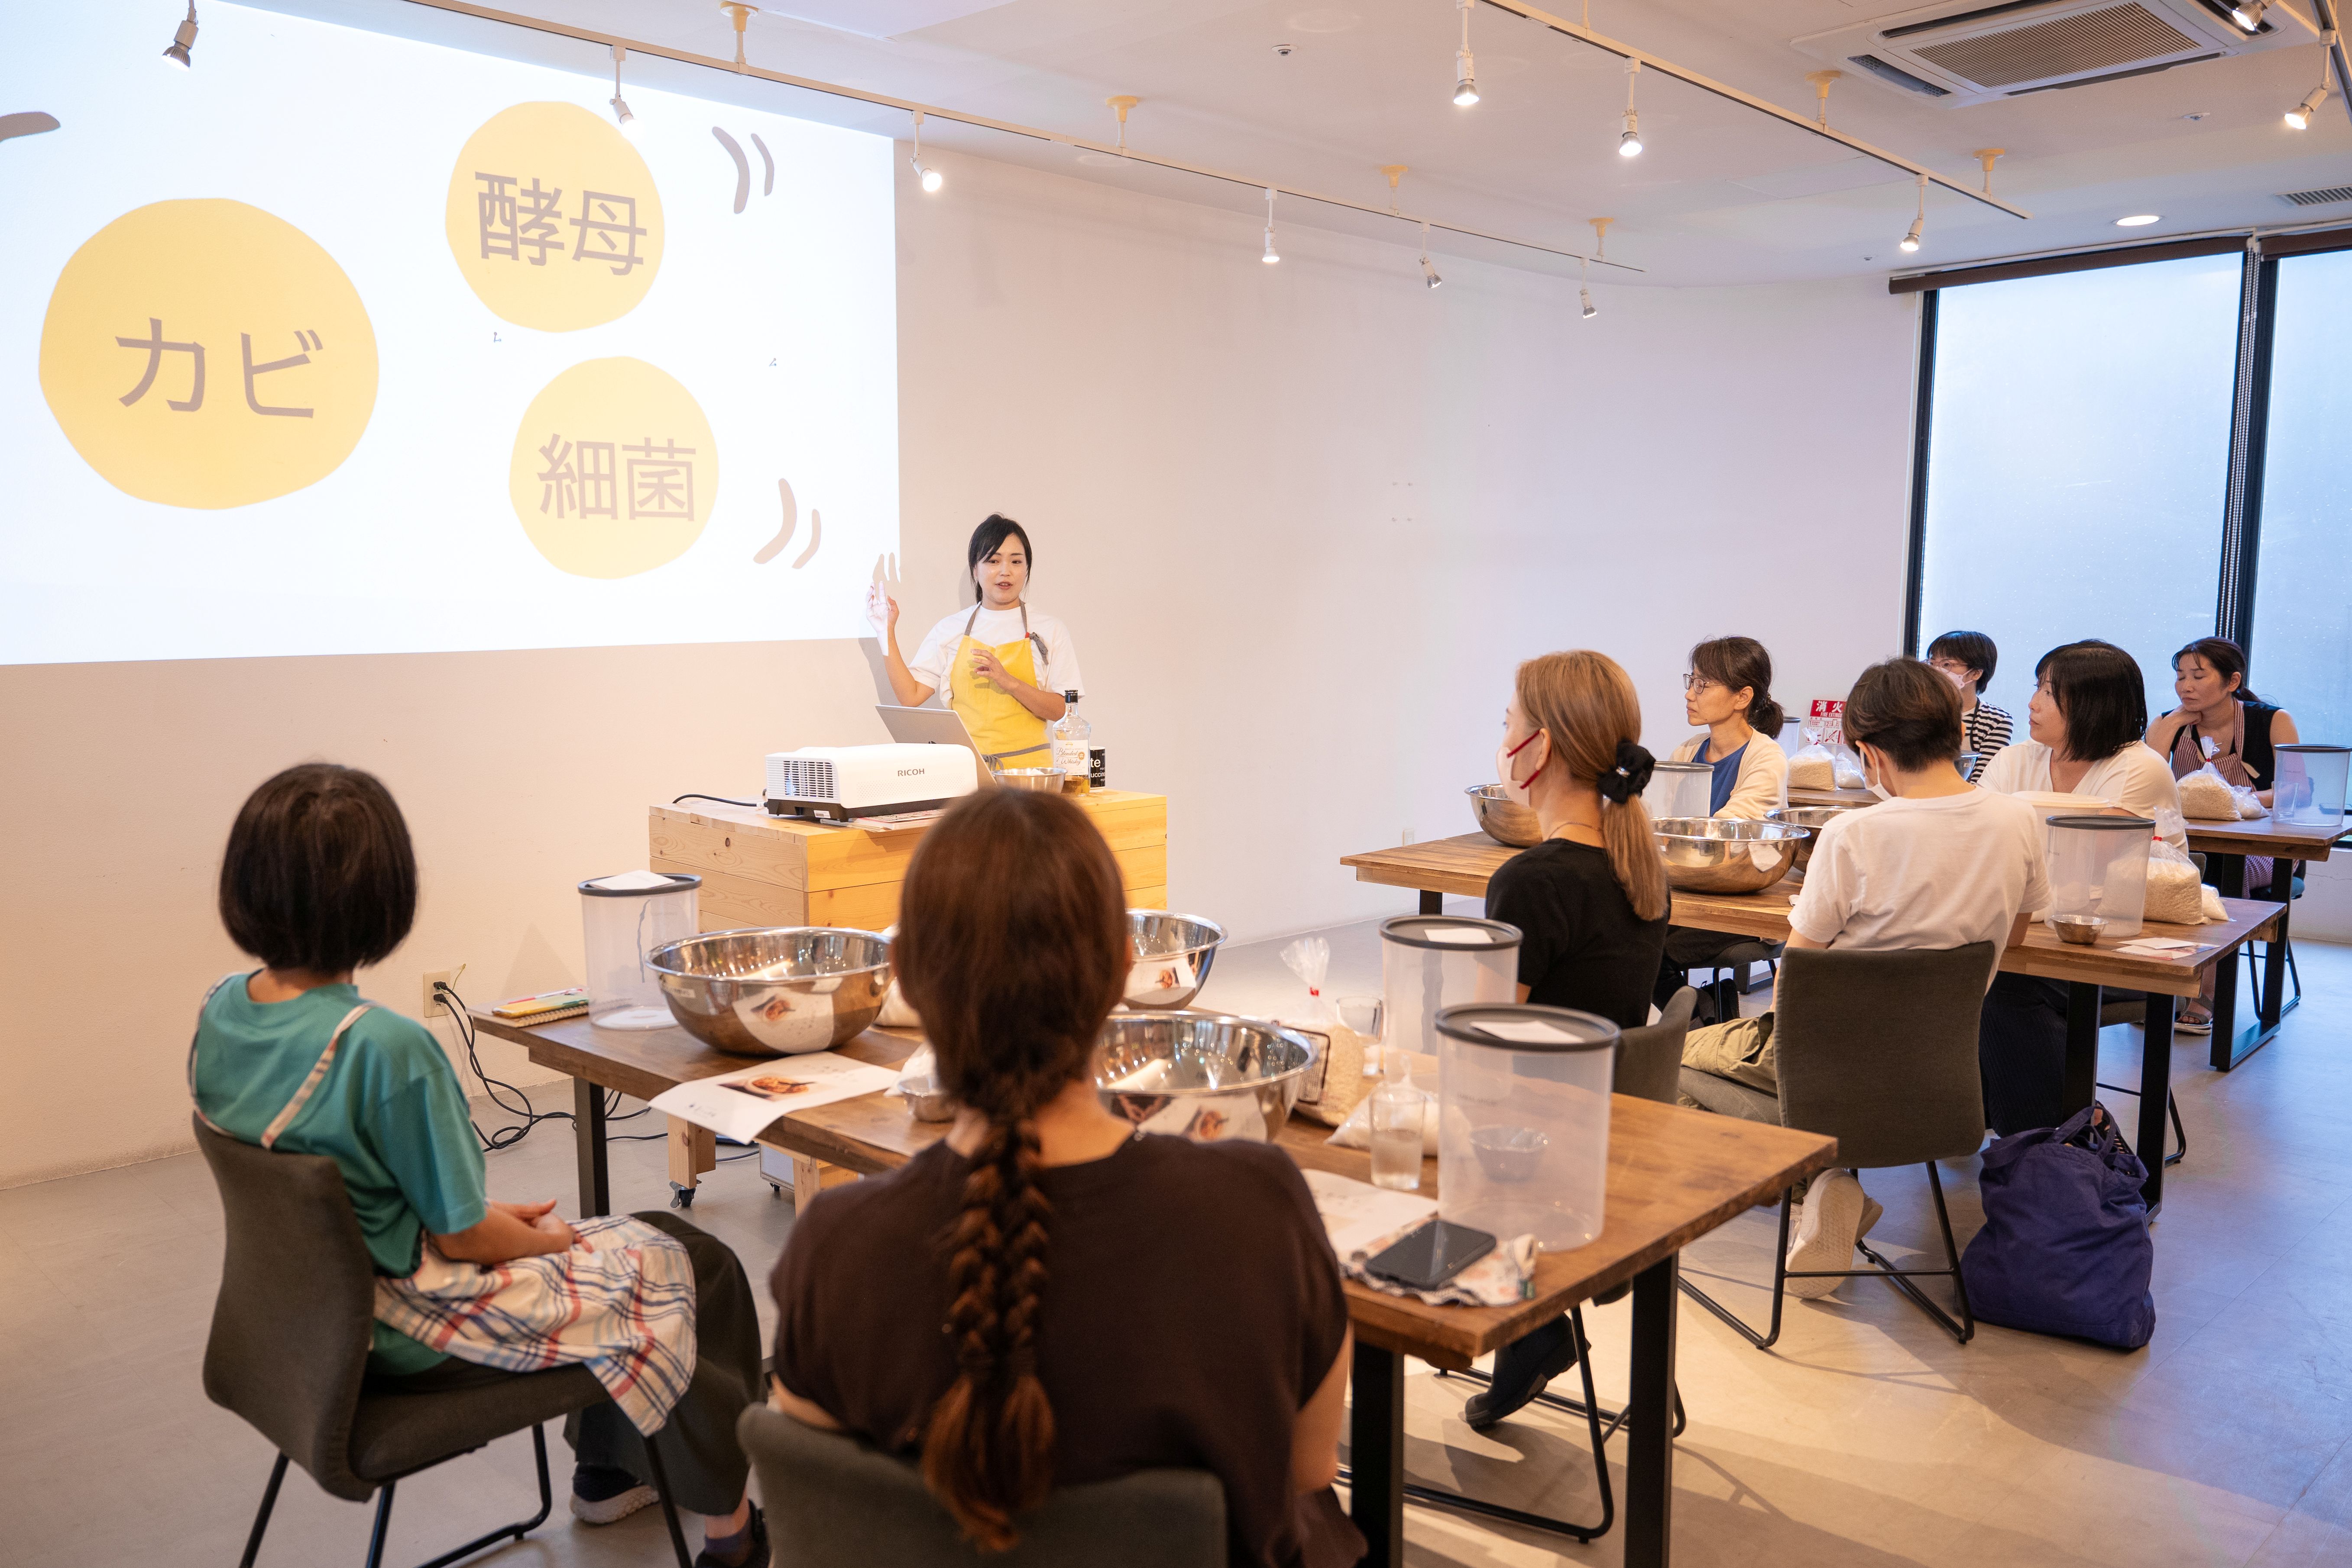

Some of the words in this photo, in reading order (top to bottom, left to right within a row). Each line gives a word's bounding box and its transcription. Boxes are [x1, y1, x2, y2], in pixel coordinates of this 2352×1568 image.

[475, 172, 647, 275] 酵母
[115, 317, 323, 418] カビ
[538, 434, 696, 521] 細菌
[1815, 700, 1843, 713] 消火
[1056, 748, 1078, 756] Blended
[1056, 756, 1081, 766] Whisky
[1090, 758, 1101, 768] te
